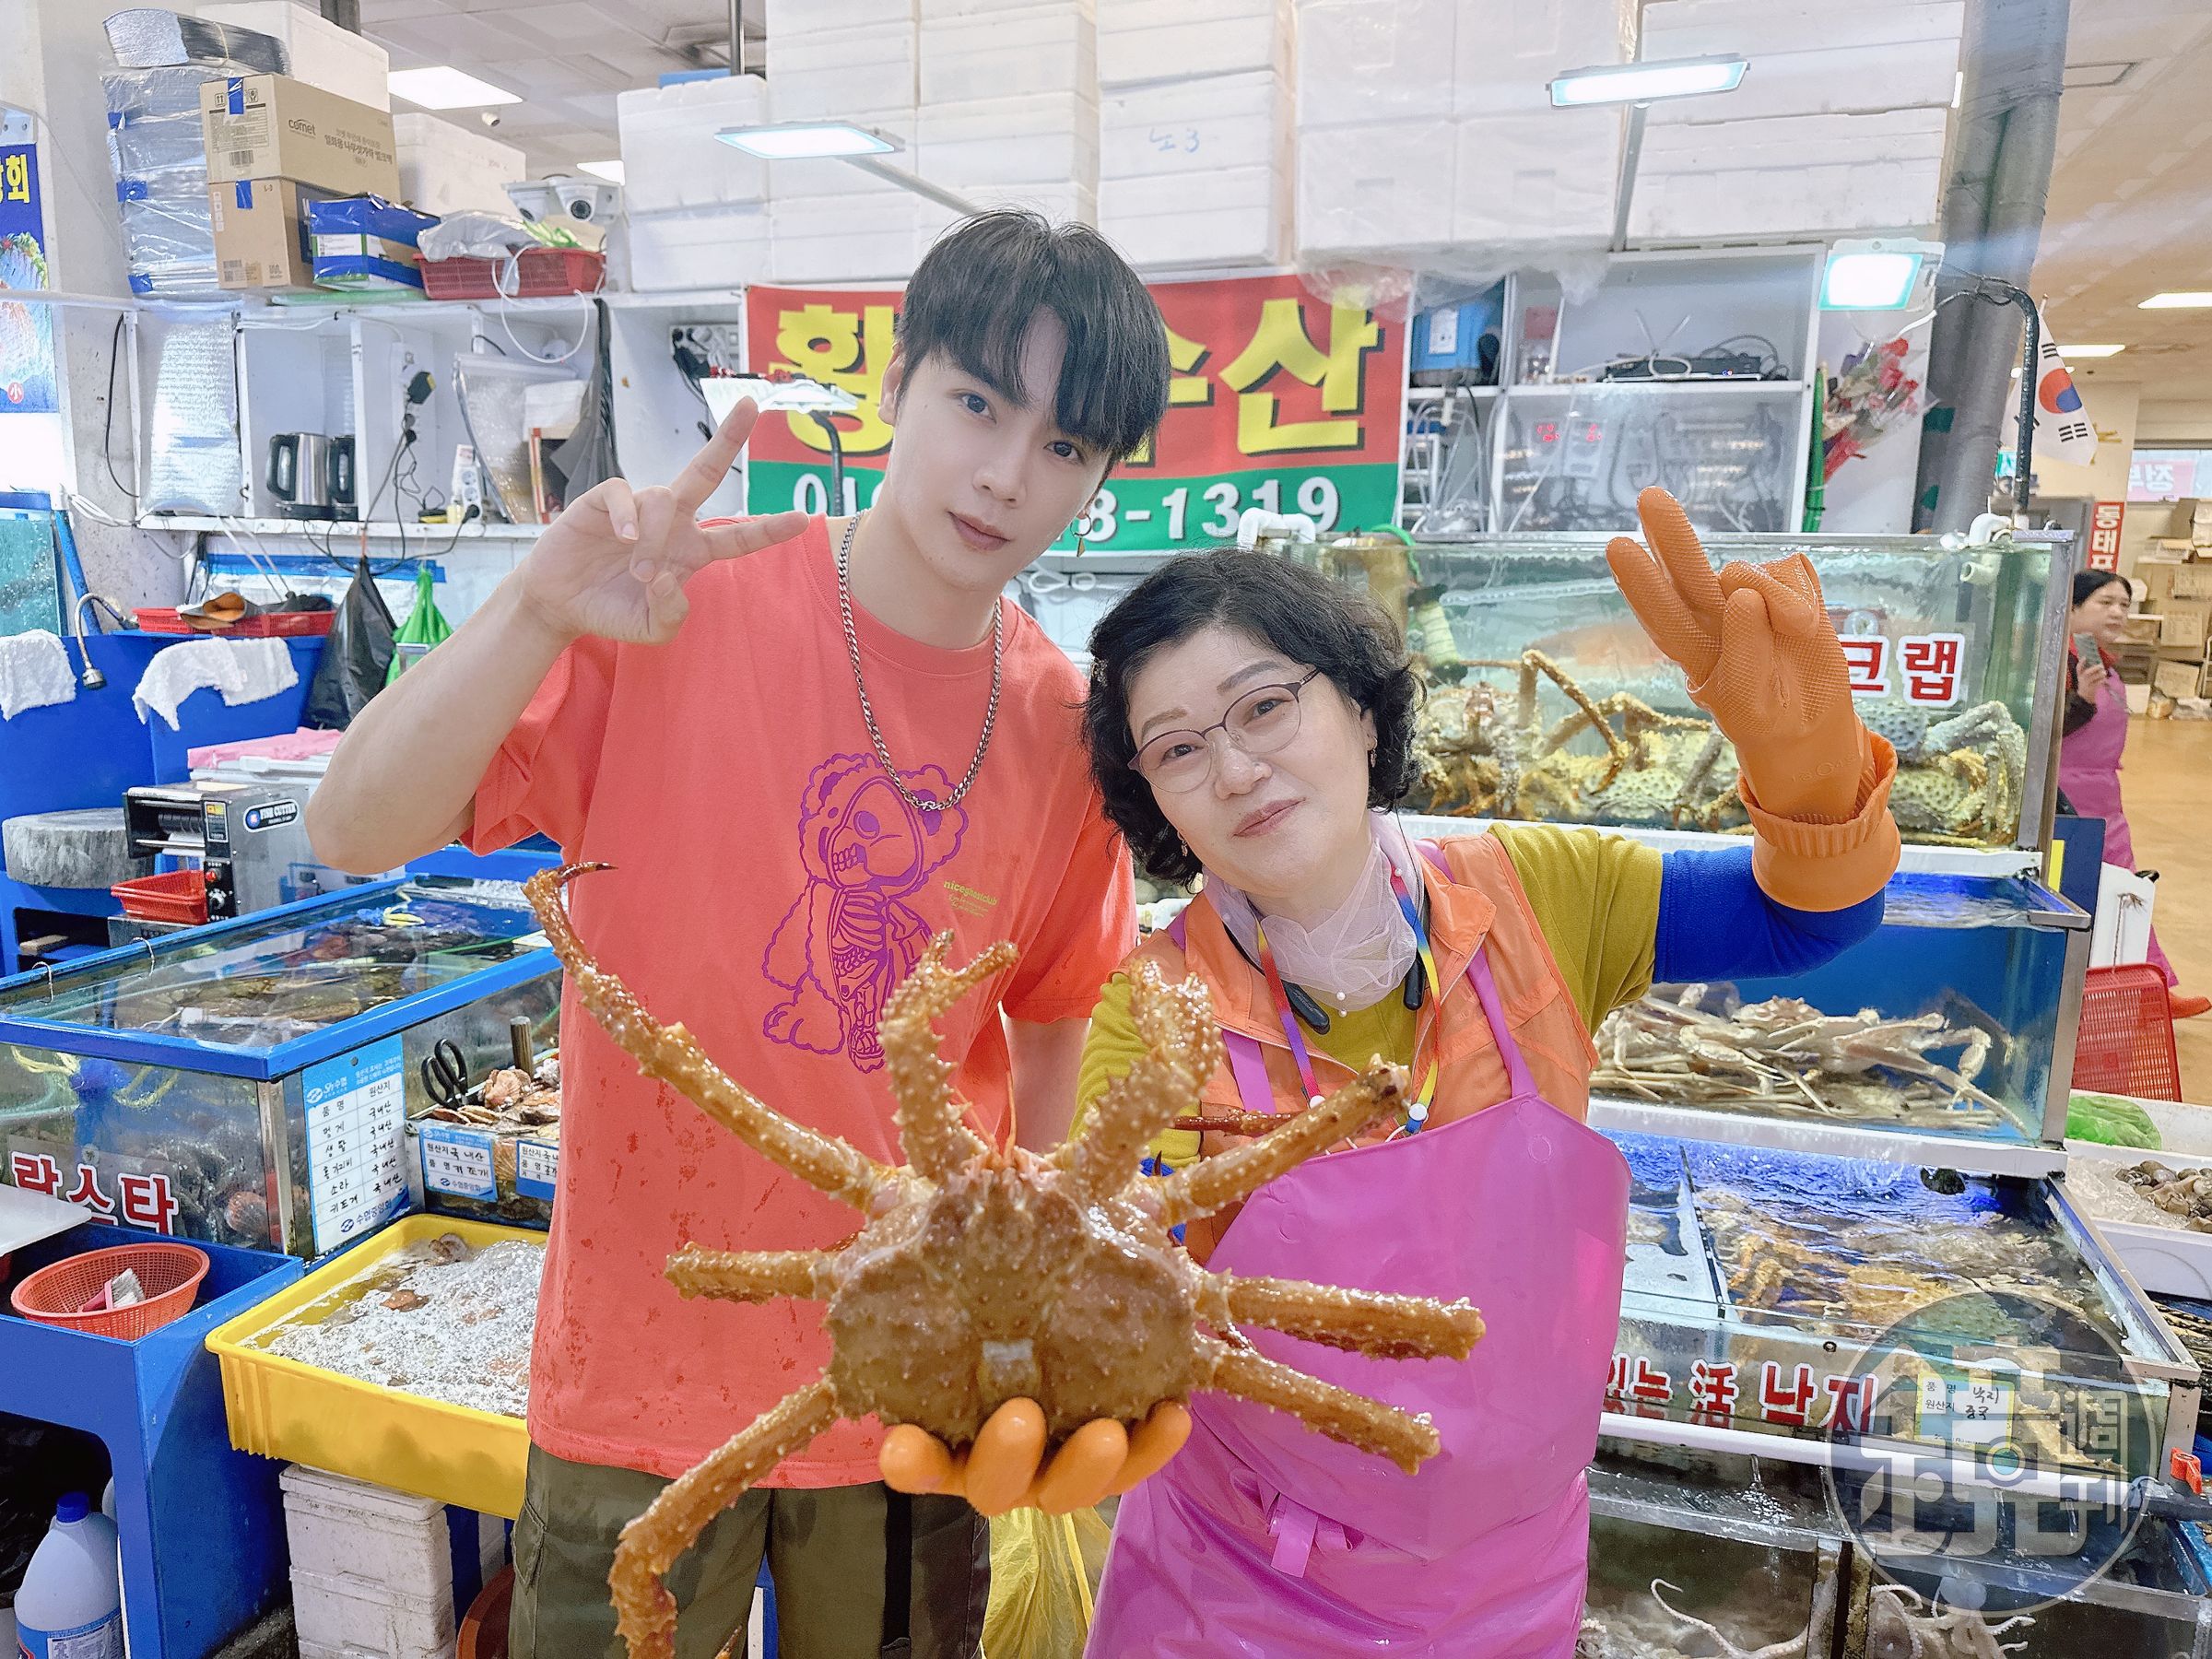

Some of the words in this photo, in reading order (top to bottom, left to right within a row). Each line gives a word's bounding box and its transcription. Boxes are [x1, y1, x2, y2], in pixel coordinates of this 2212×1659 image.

[0, 153, 30, 205] 회
[1057, 476, 1340, 543] 8-1319
[369, 1080, 391, 1098] 원산지
[369, 1100, 392, 1121] 국내산
[370, 1119, 393, 1139] 국내산
[371, 1138, 394, 1158] 국내산
[427, 1143, 449, 1155] 원산지
[522, 1146, 541, 1159] 원산지
[371, 1155, 396, 1175] 국내산
[372, 1172, 403, 1194] 국내산
[1925, 1399, 1956, 1412] 원산지
